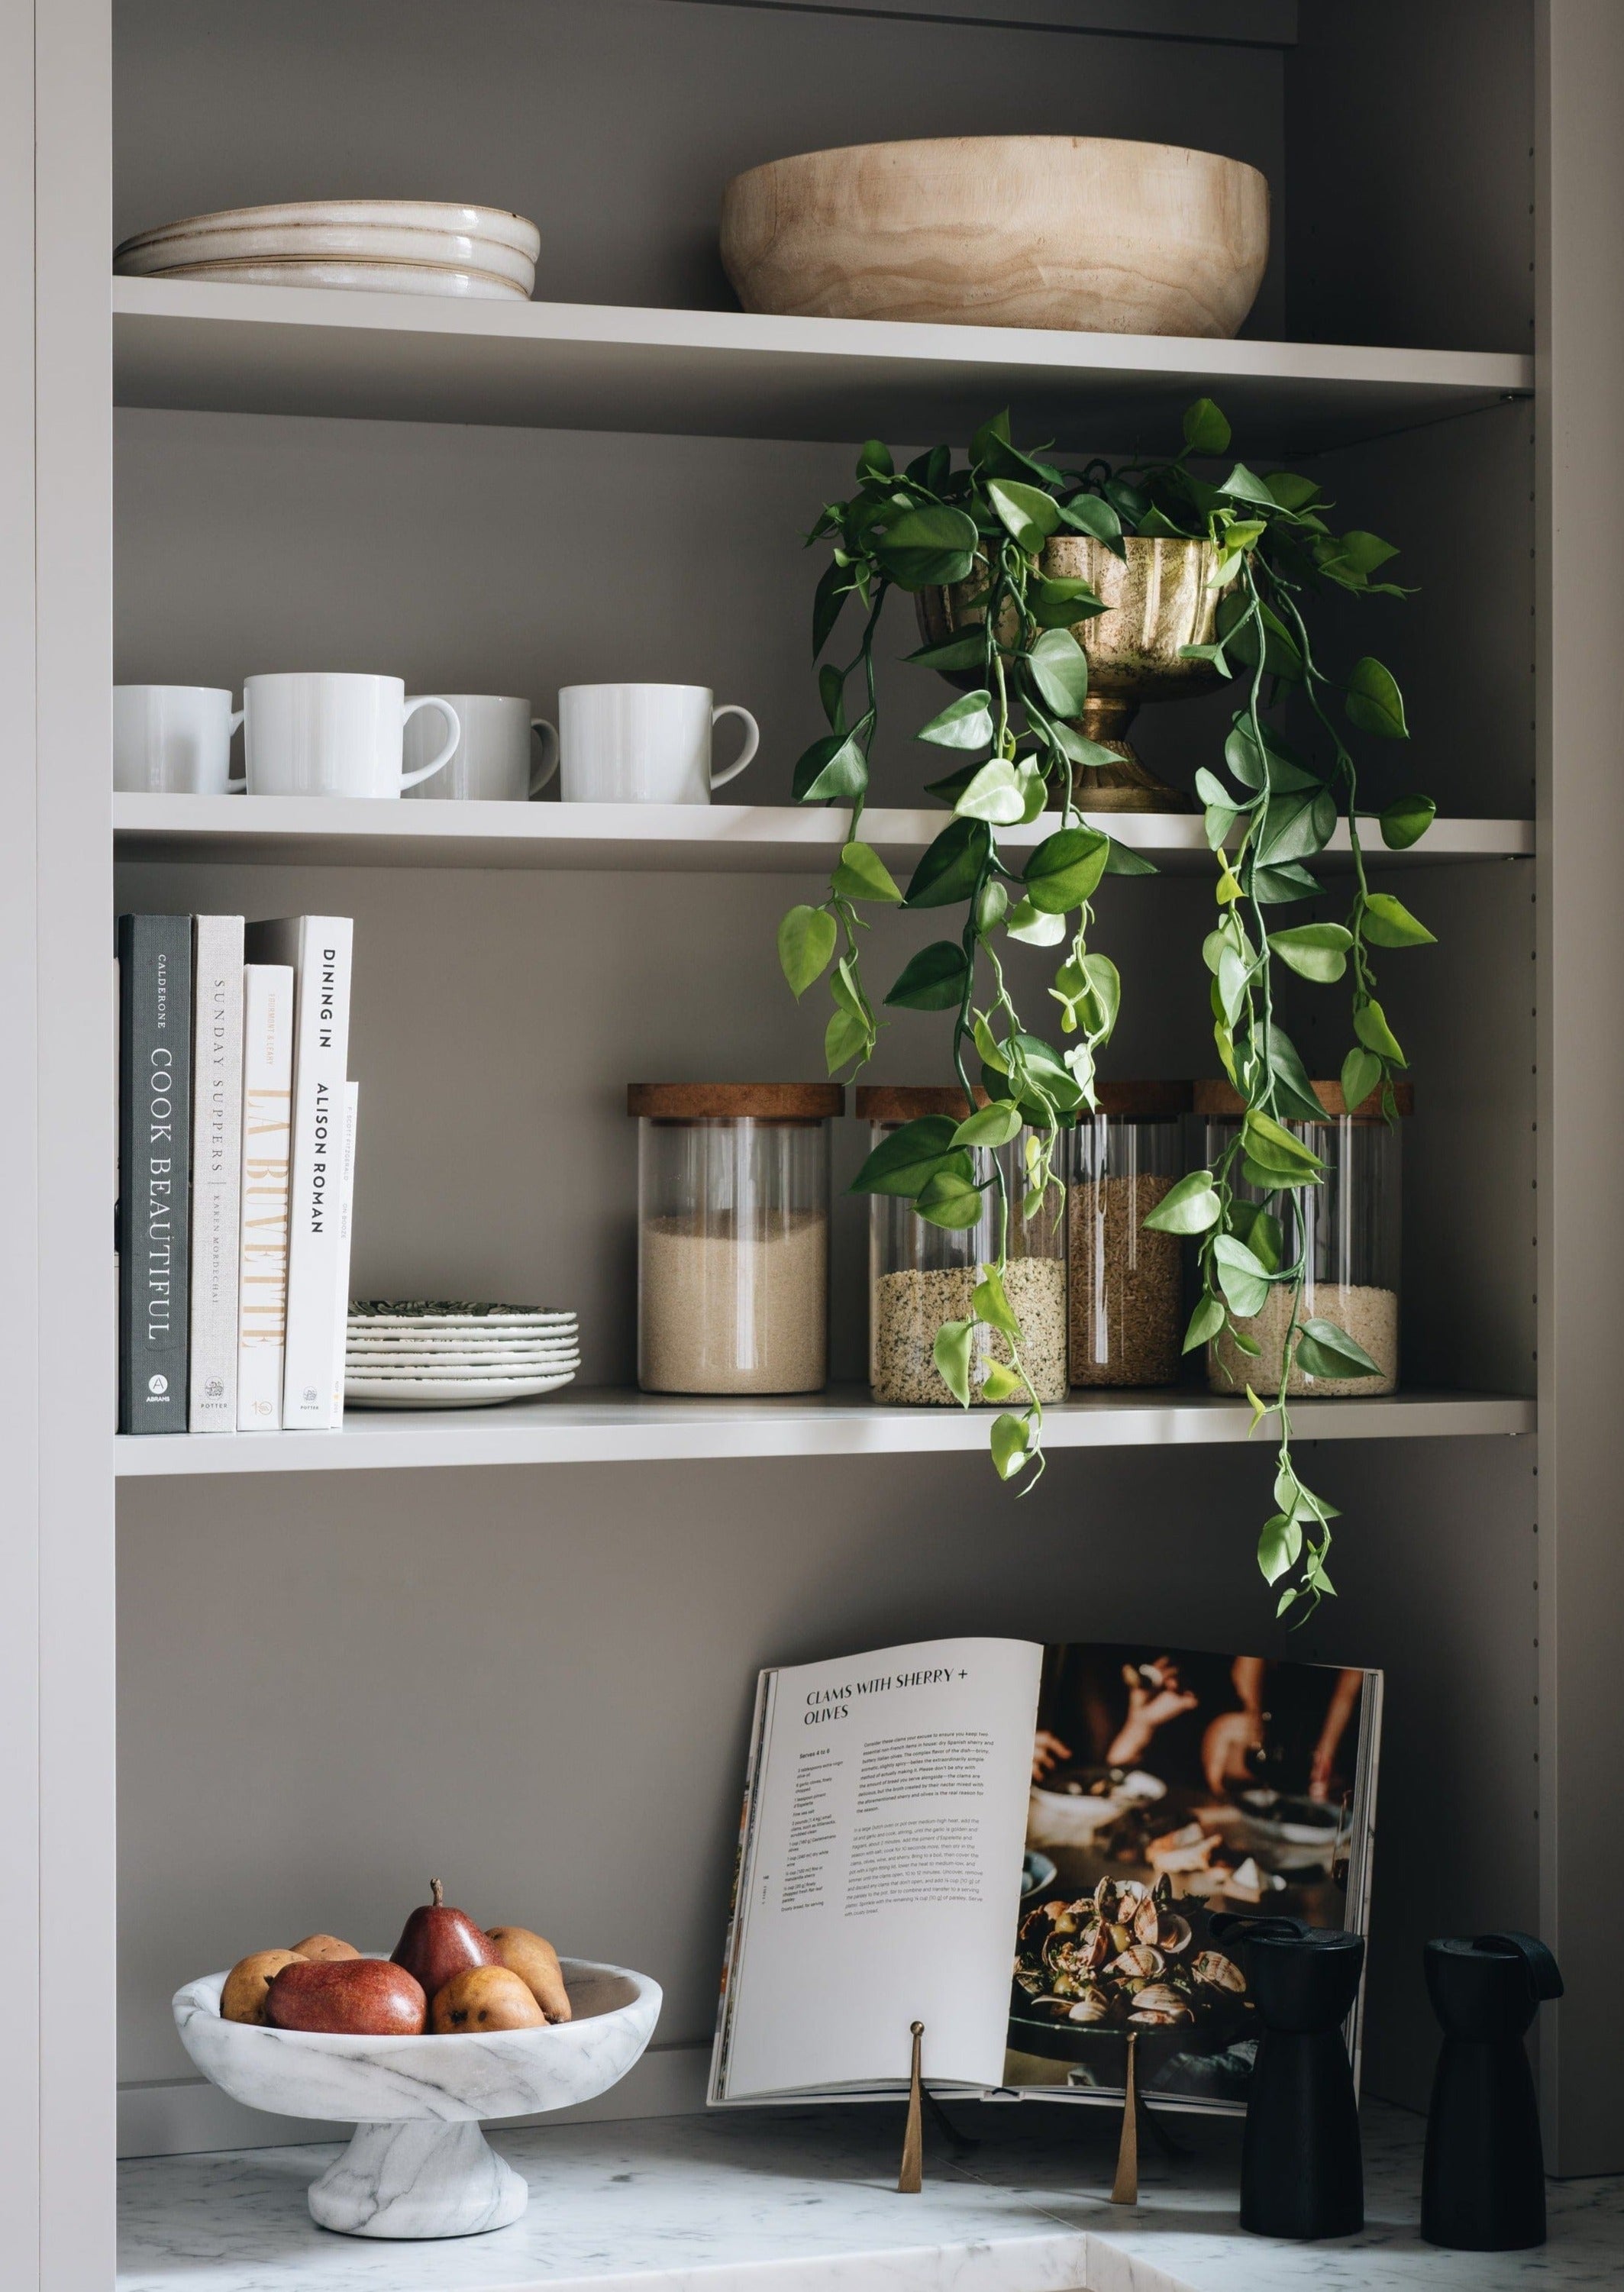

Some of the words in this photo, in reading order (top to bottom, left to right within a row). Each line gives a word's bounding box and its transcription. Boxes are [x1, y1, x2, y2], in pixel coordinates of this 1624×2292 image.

[158, 954, 166, 1028] CALDERONE
[320, 949, 336, 1020] DINING
[213, 980, 225, 1066] SUNDAY
[319, 1029, 332, 1048] IN
[150, 1048, 173, 1142] COOK
[212, 1080, 224, 1171] SUPPERS
[247, 1090, 291, 1135] LA
[315, 1083, 329, 1154] ALISON
[312, 1163, 326, 1233] ROMAN
[148, 1157, 172, 1340] BEAUTIFUL
[241, 1158, 289, 1348] BUVETTE
[804, 1704, 849, 1725] OLIVES
[806, 1684, 852, 1706] CLAMS
[857, 1677, 891, 1696] WITH
[896, 1668, 954, 1688] SHERRY
